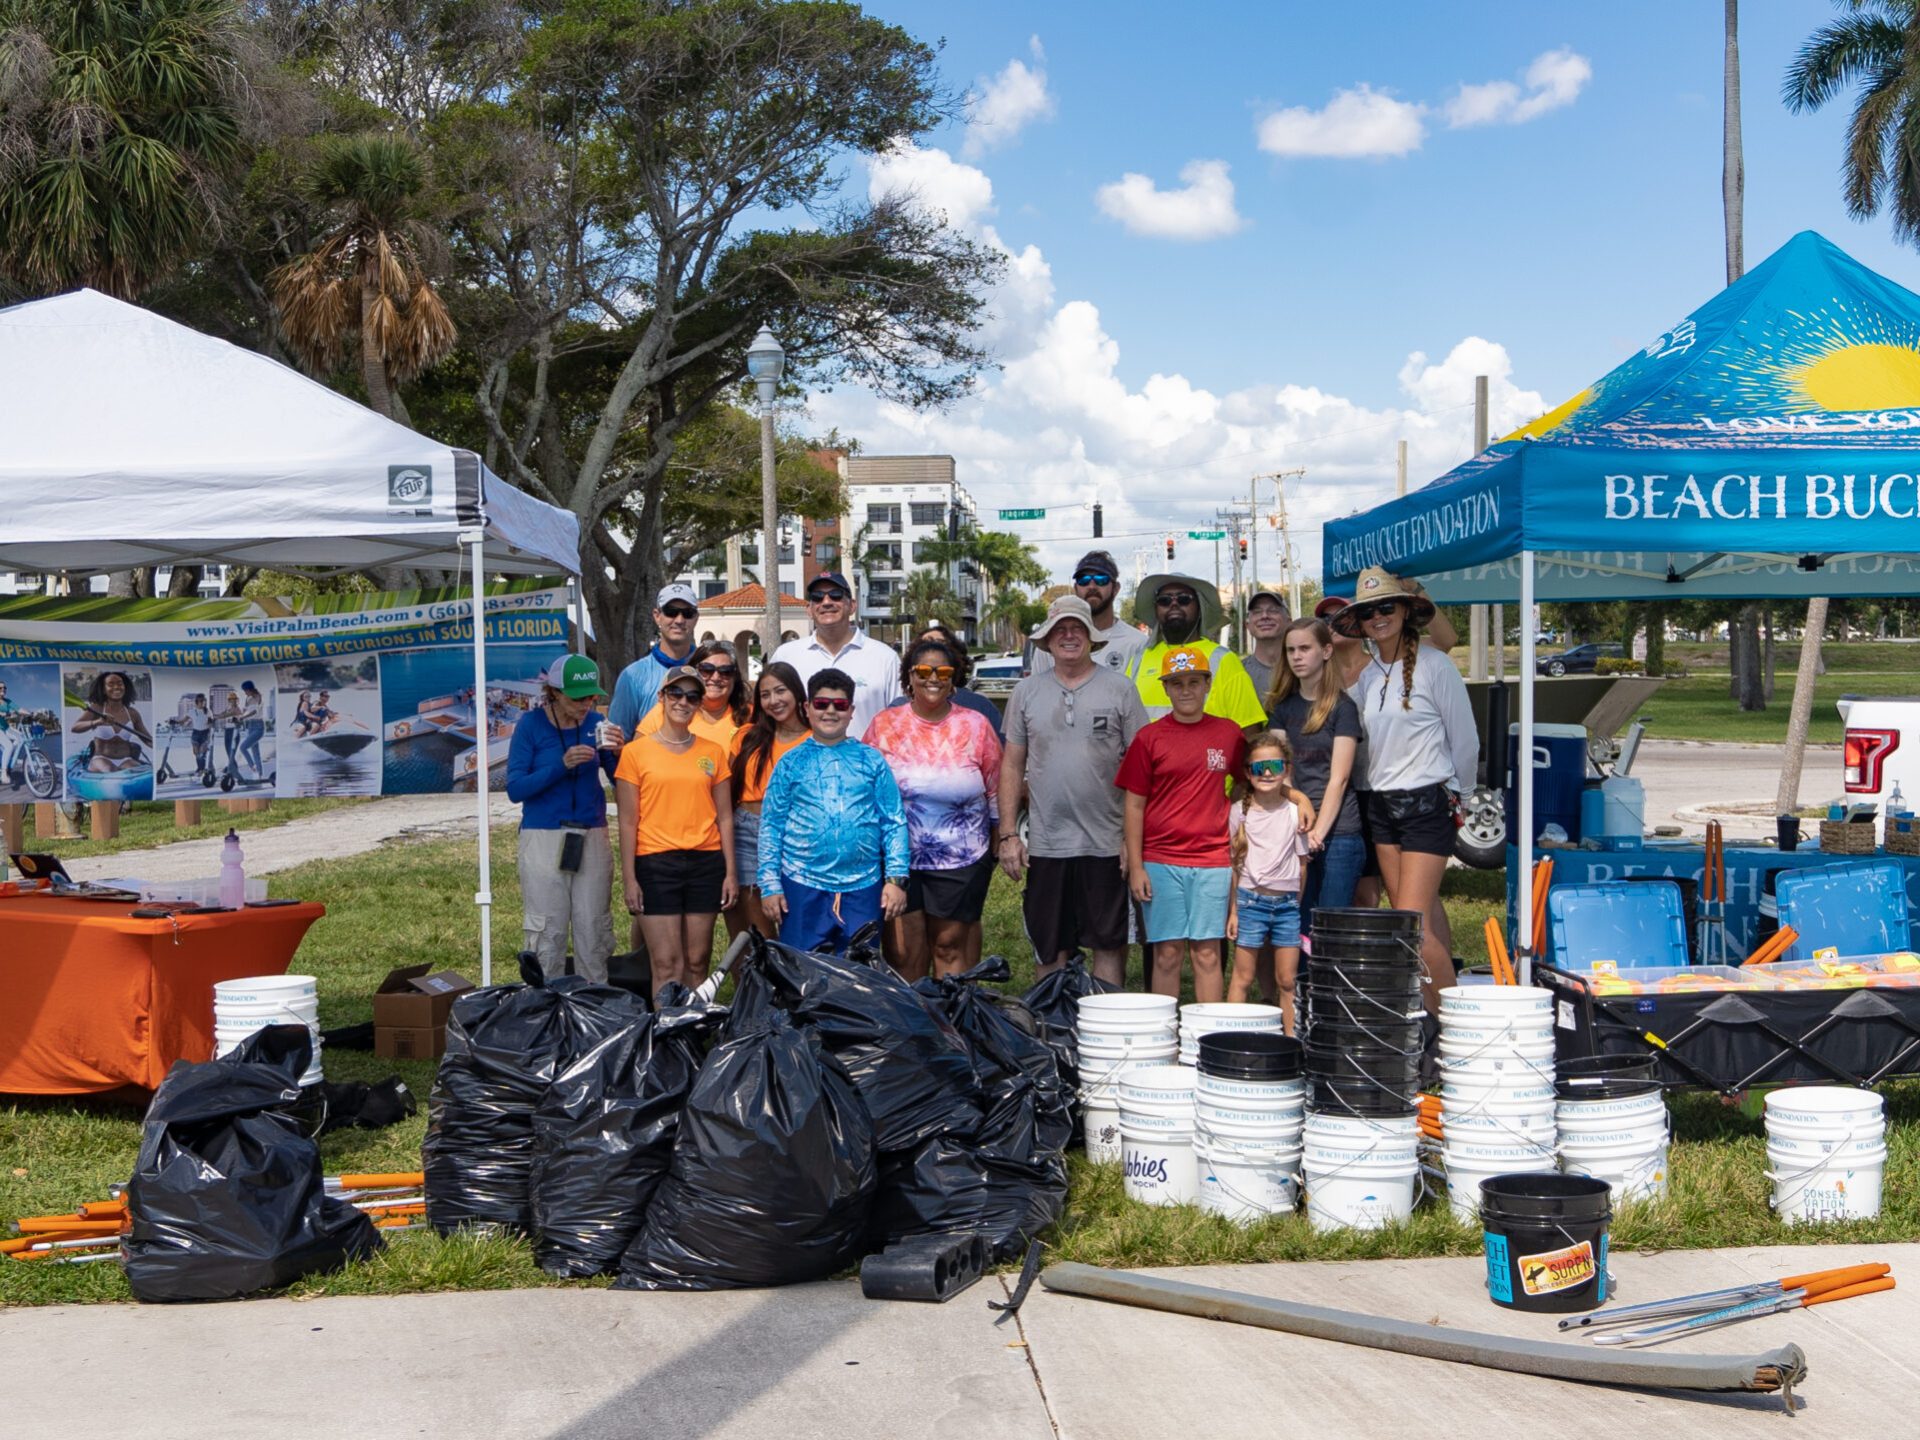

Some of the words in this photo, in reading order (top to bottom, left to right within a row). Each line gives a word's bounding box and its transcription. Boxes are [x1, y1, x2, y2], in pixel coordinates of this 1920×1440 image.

[1838, 409, 1920, 429] YO
[1604, 474, 1787, 520] BEACH
[1805, 474, 1920, 520] BUC
[1332, 535, 1365, 577] BEACH
[1365, 521, 1409, 567] BUCKET
[1411, 486, 1500, 553] FOUNDATION
[46, 647, 144, 664] NAVIGATORS
[149, 651, 168, 665] OF
[176, 650, 203, 666] THE
[209, 648, 245, 666] BEST
[251, 643, 303, 663] TOURS
[308, 641, 321, 656] &
[324, 632, 415, 656] EXCURIONS
[420, 629, 437, 643] IN
[441, 621, 494, 640] SOUH
[499, 618, 563, 638] FLORIDA
[187, 612, 410, 637] www.VisitPalmBeach.com
